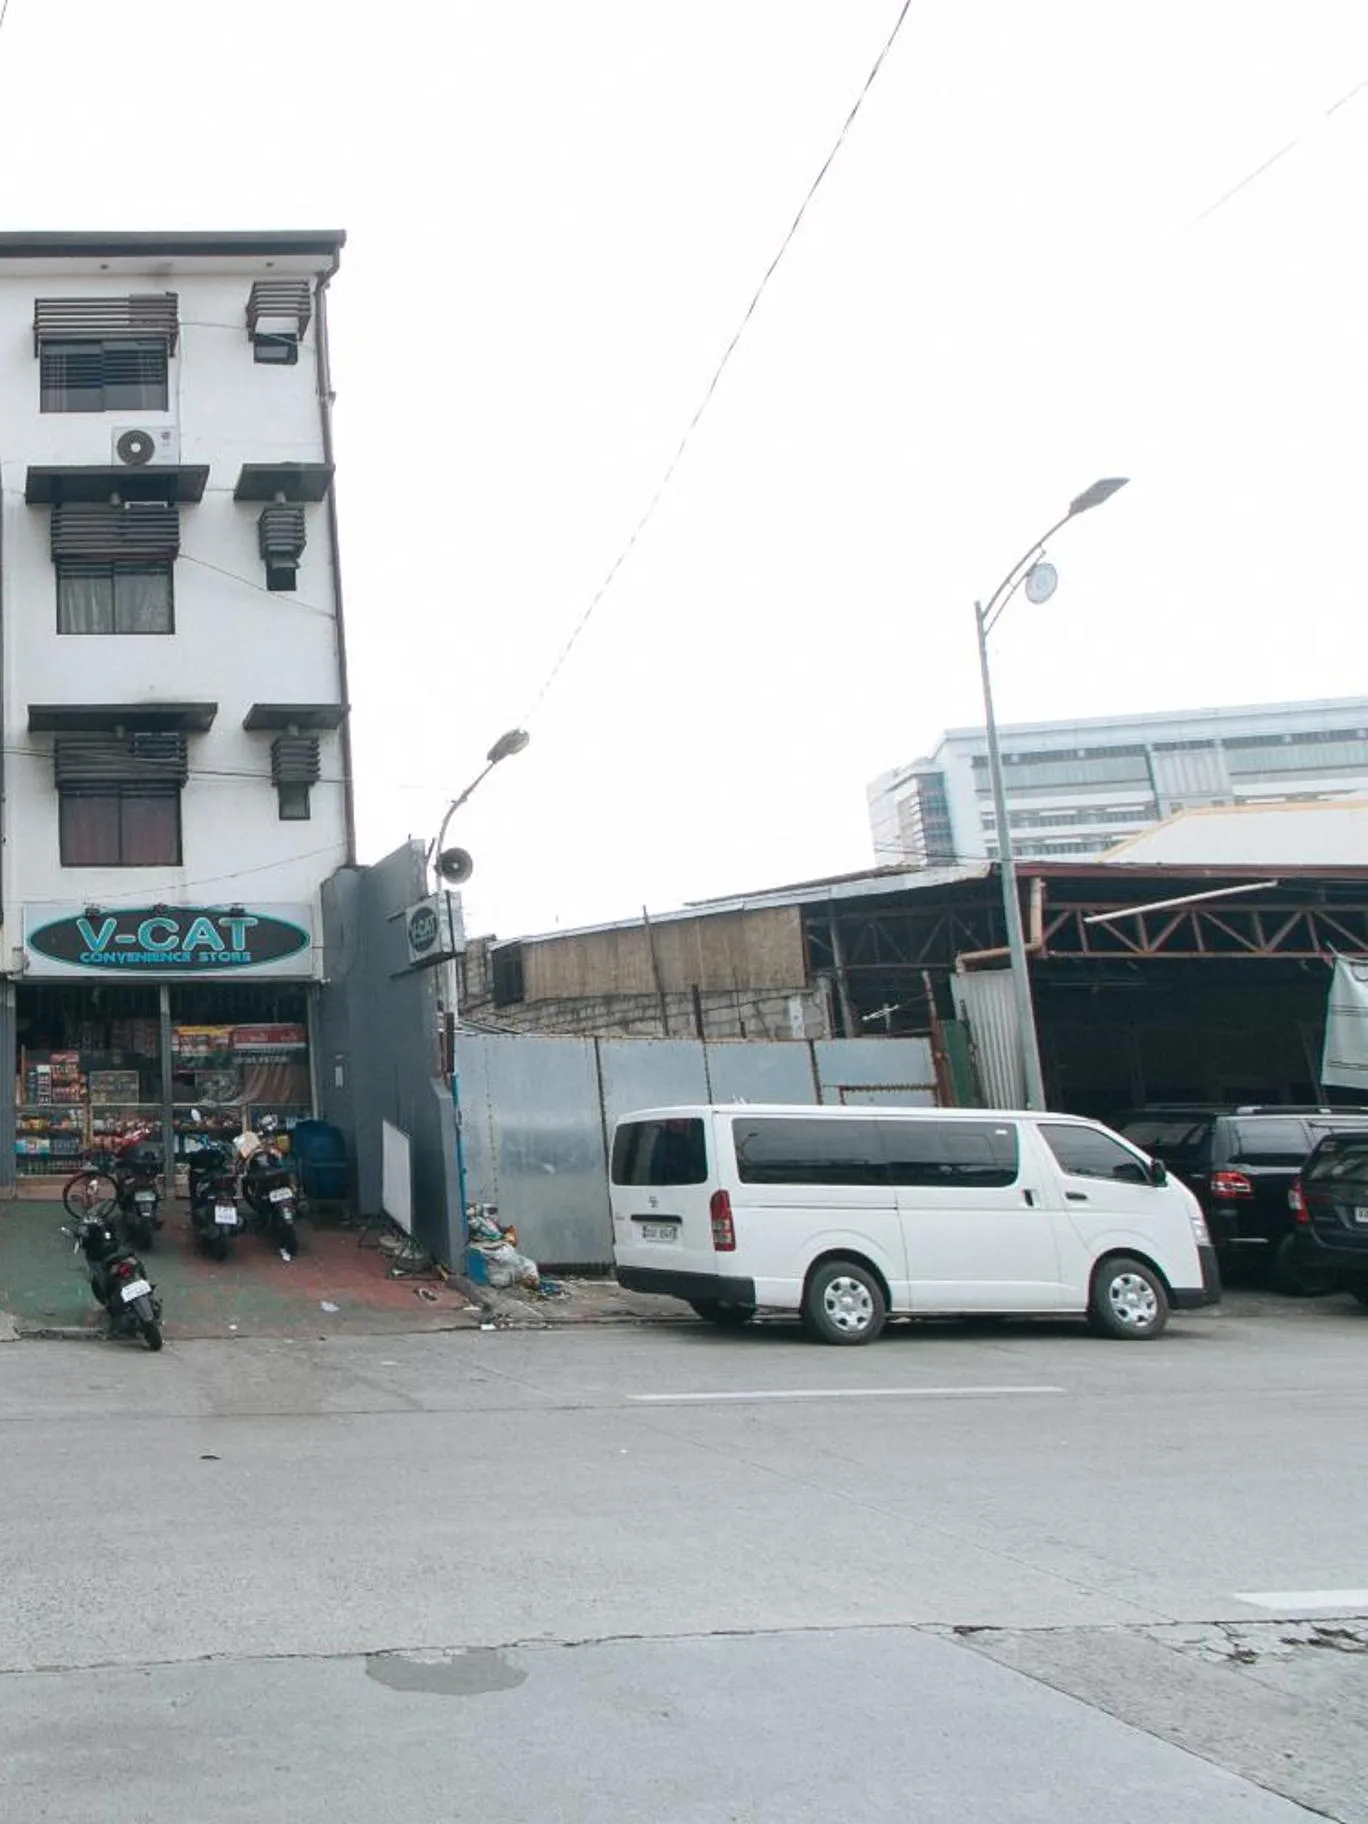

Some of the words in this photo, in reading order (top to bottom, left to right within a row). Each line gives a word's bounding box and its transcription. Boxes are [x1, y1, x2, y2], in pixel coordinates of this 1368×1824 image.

[76, 917, 259, 951] V-CAT
[80, 951, 192, 964] CONVENIENCE
[199, 951, 252, 964] STORE
